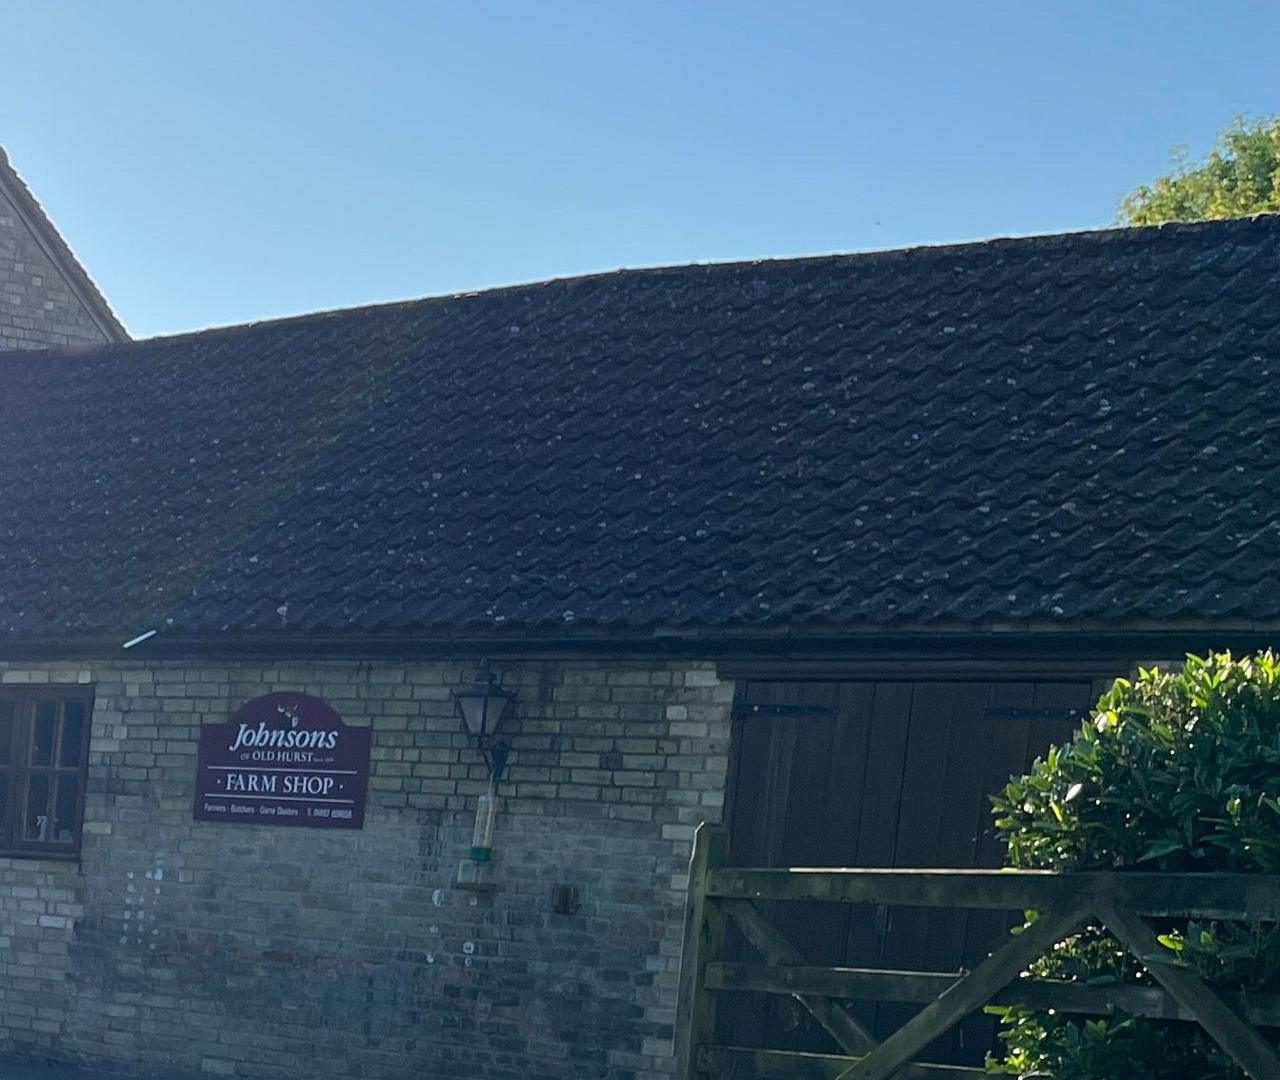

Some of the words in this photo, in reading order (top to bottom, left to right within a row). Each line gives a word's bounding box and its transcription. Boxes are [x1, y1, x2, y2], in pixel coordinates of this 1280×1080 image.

[229, 722, 338, 751] Johnsons
[252, 751, 275, 761] OLD
[277, 752, 313, 763] HURST
[226, 774, 277, 792] FARM
[283, 776, 334, 794] SHOP
